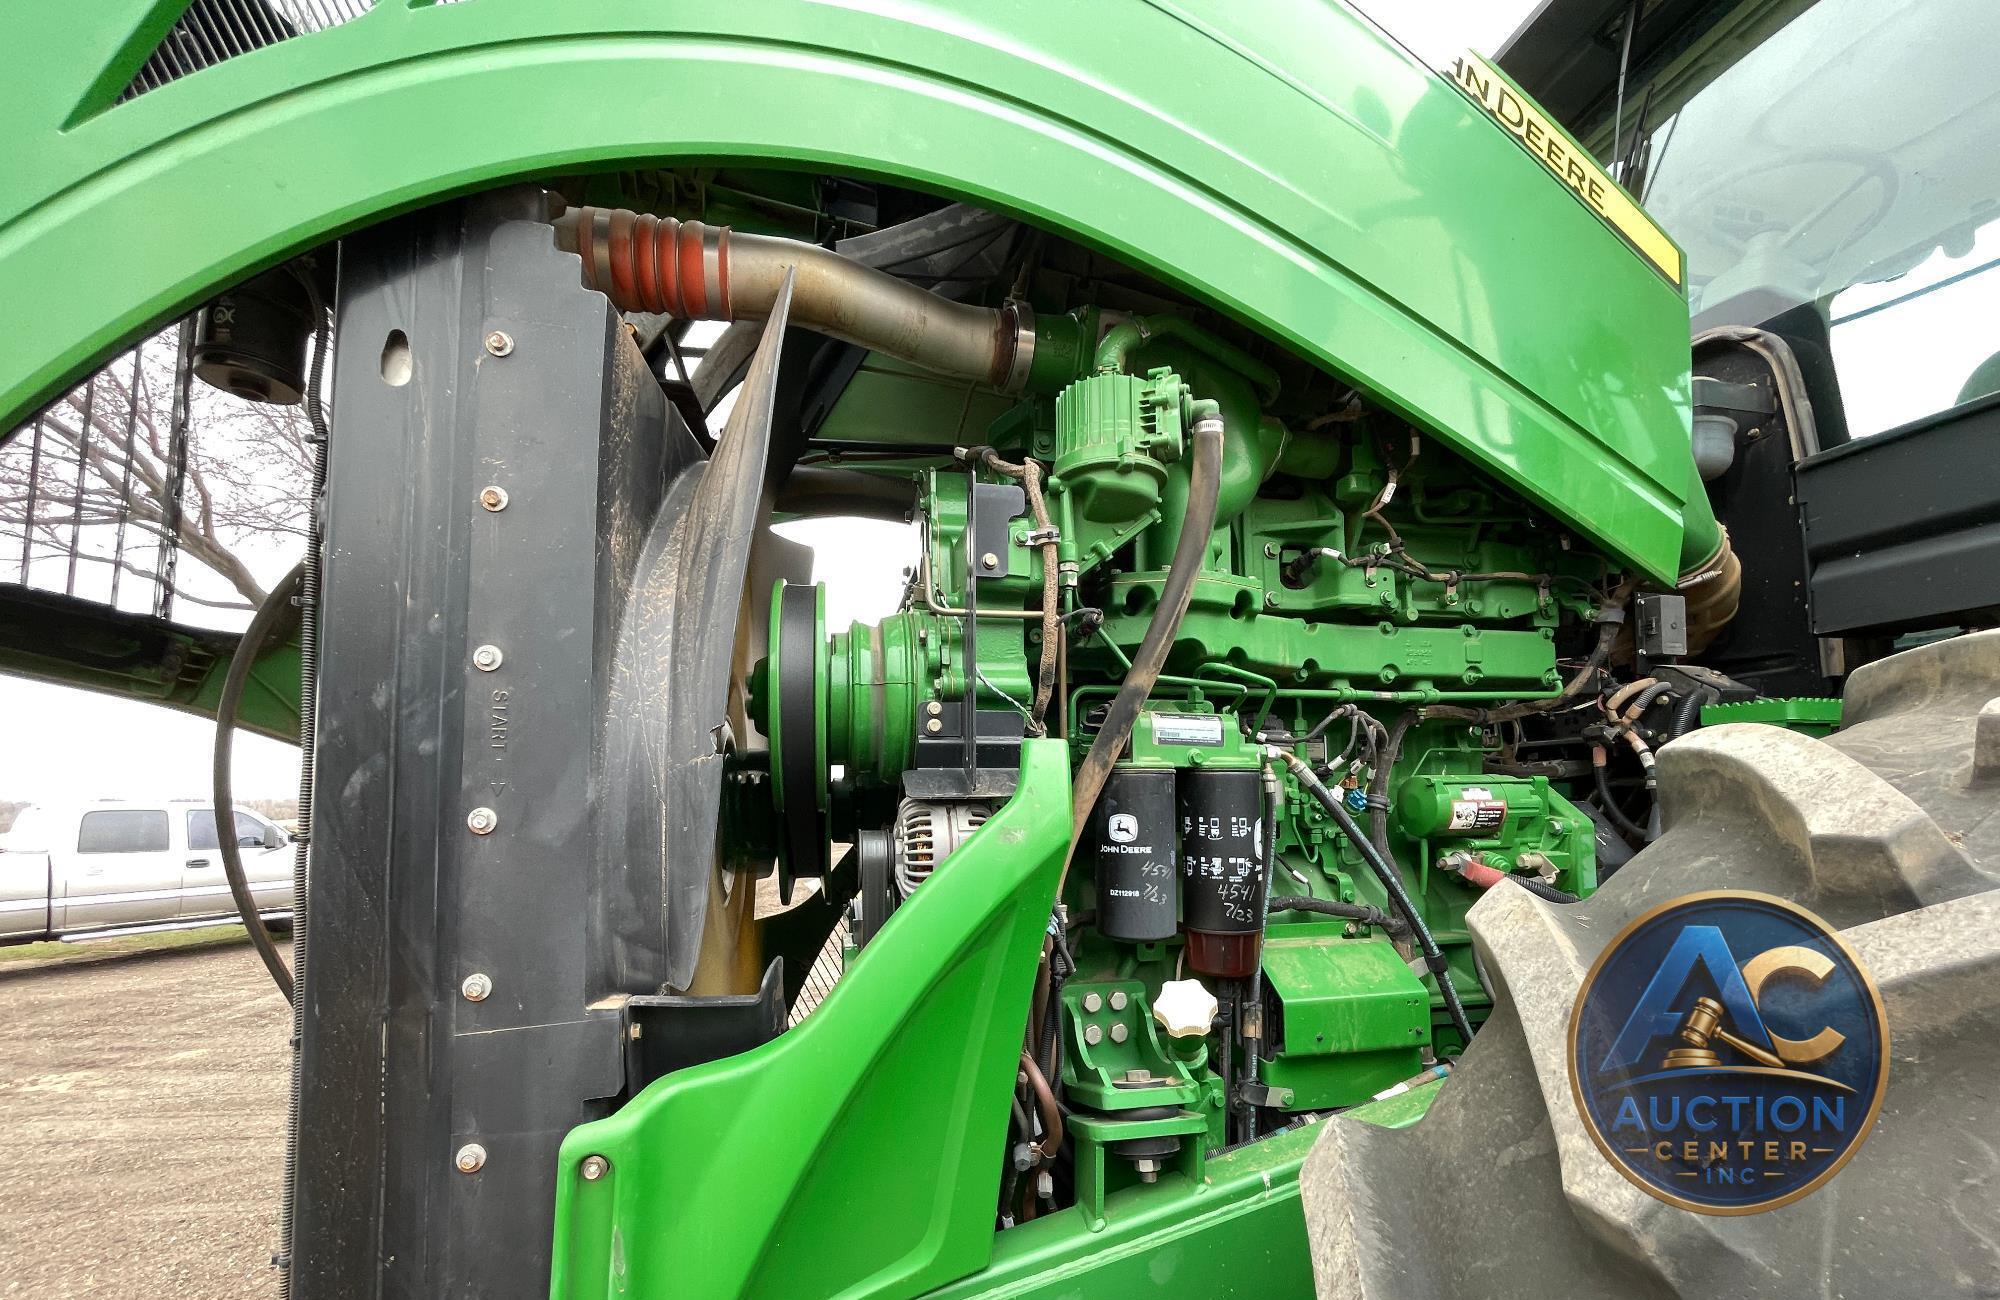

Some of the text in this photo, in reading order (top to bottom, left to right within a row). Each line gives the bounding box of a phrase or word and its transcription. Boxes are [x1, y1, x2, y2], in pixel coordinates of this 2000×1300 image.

[1497, 86, 1605, 211] DEERE
[491, 689, 509, 752] START
[1100, 843, 1153, 854] JOHN DEERE
[1217, 883, 1257, 902] 4541
[1223, 902, 1254, 924] 7/23
